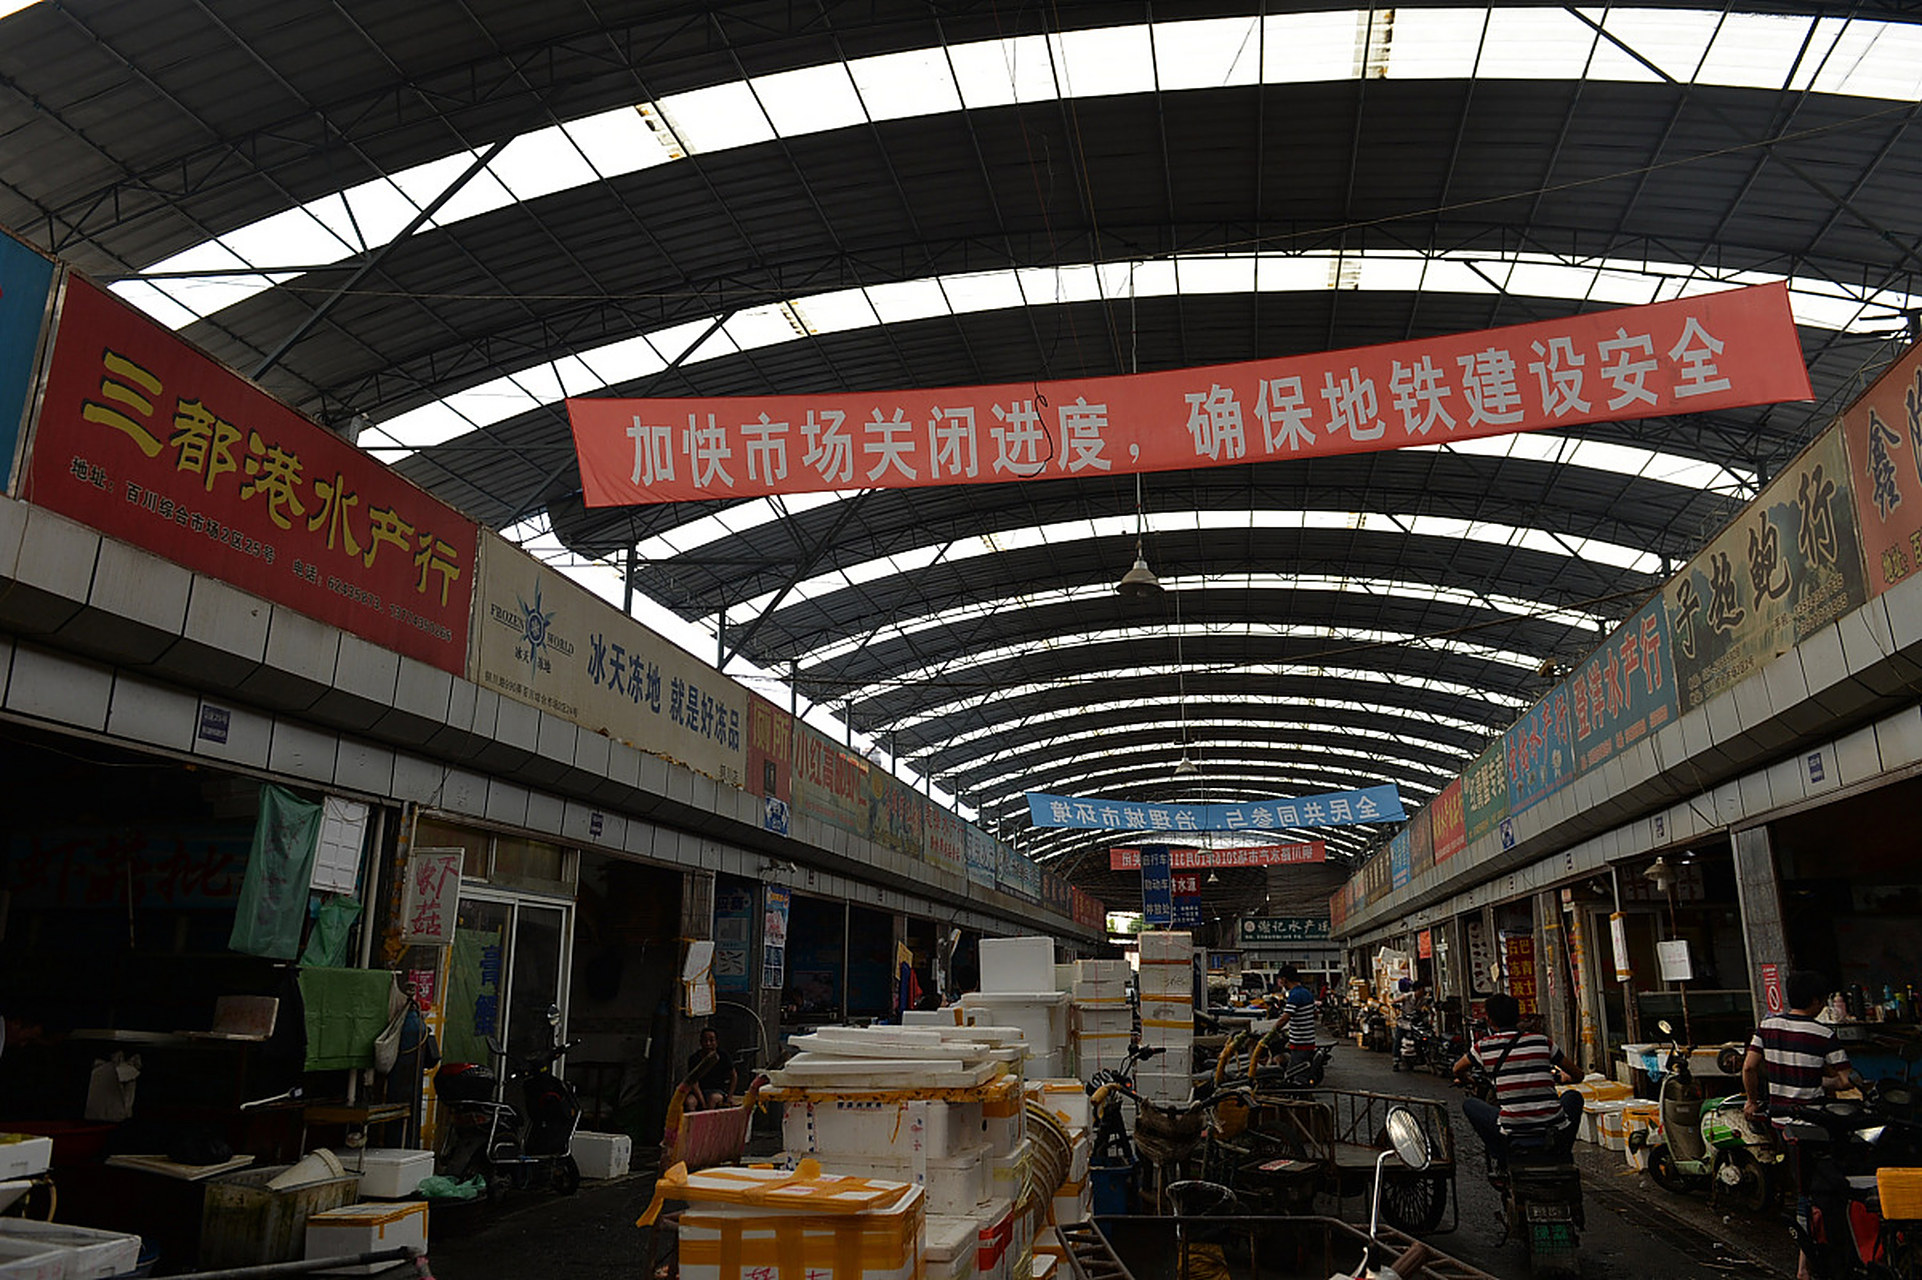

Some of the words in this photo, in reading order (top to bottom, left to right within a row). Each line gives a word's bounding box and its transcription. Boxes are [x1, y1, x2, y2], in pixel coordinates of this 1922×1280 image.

[82, 347, 460, 607] 三都港水产行
[490, 603, 525, 630] FROZEN
[546, 632, 575, 655] WORLD
[588, 634, 661, 714] 冰天冻地
[669, 677, 740, 752] 就是好冻品
[1572, 612, 1662, 741] 登洋水产行
[753, 700, 789, 763] 厕所
